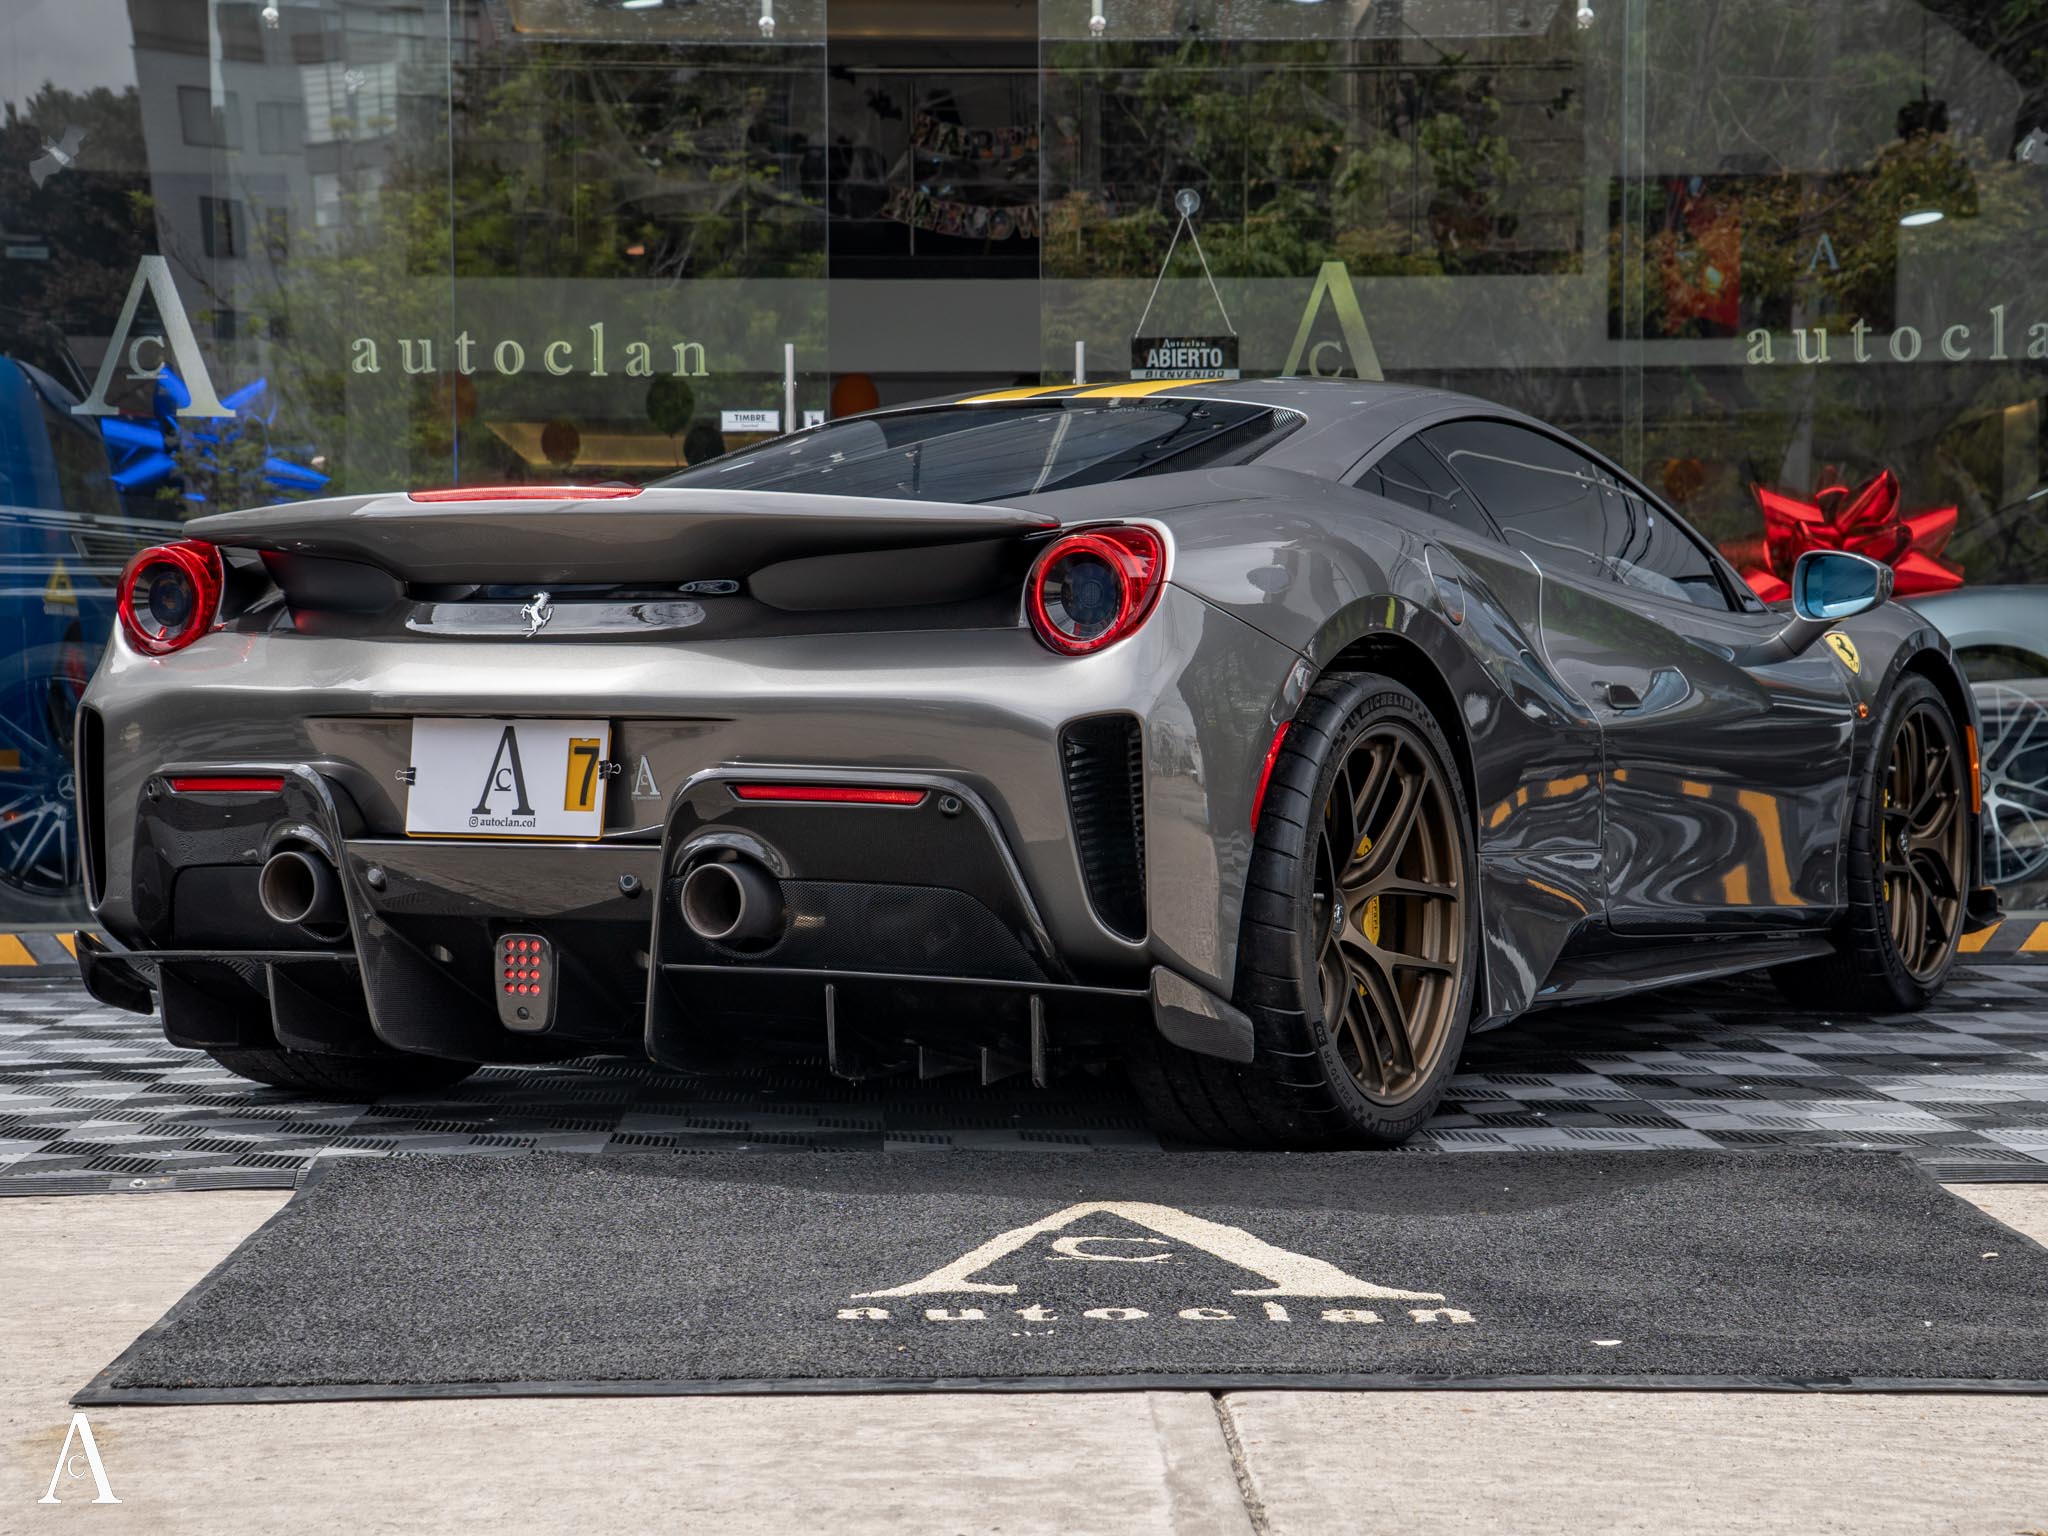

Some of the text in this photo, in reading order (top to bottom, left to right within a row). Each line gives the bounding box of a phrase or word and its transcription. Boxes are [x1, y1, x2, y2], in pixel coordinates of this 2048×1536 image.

[351, 321, 711, 376] autoclan
[1146, 348, 1223, 369] ABIERTO
[1145, 370, 1226, 379] BIENVENIDO
[734, 414, 766, 422] TIMBRE
[1360, 692, 1413, 718] MICHELIN
[574, 746, 600, 806] 7
[836, 1301, 1477, 1324] autoclan
